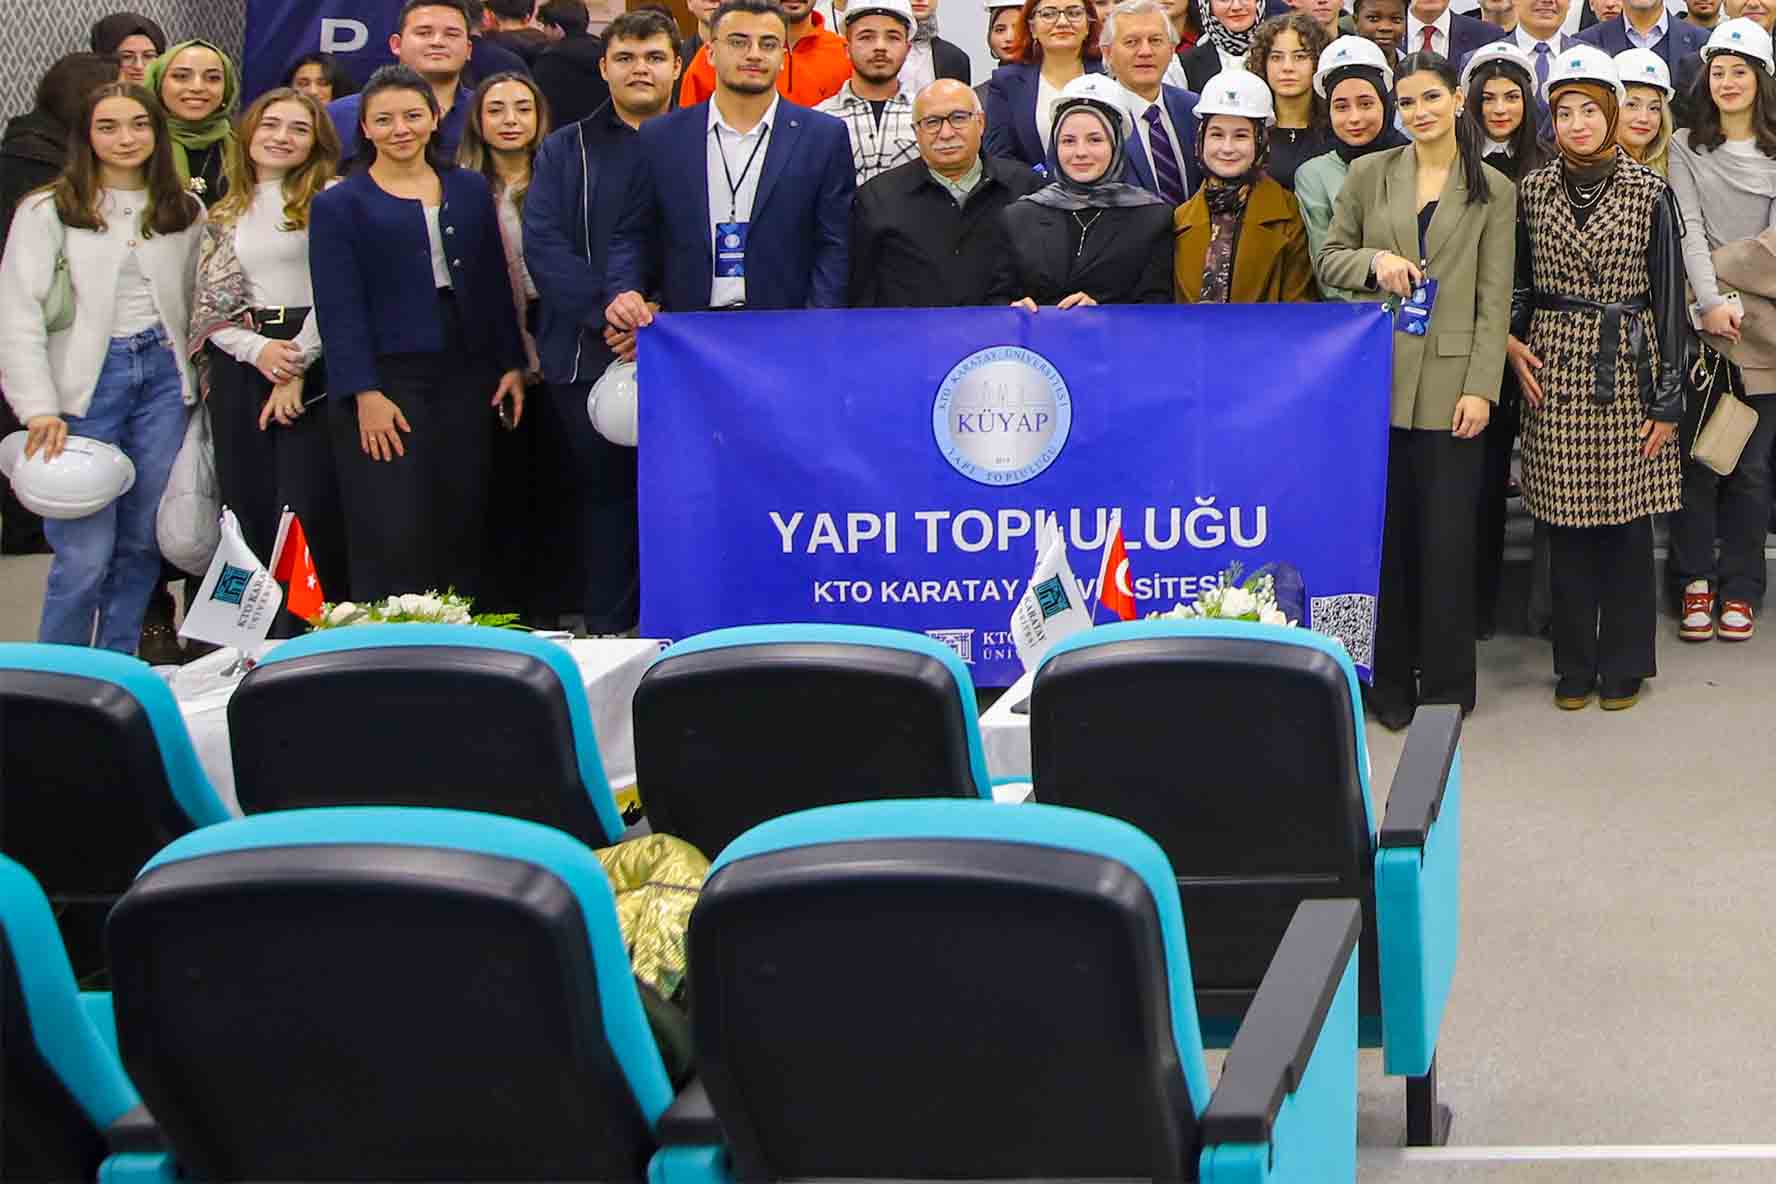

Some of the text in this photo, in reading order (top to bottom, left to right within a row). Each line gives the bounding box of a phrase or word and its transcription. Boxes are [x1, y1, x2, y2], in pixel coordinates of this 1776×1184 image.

[957, 408, 1050, 433] KÜYAP
[769, 510, 897, 554] YAPI
[813, 580, 873, 603] KTO
[881, 578, 1020, 603] KARATAY
